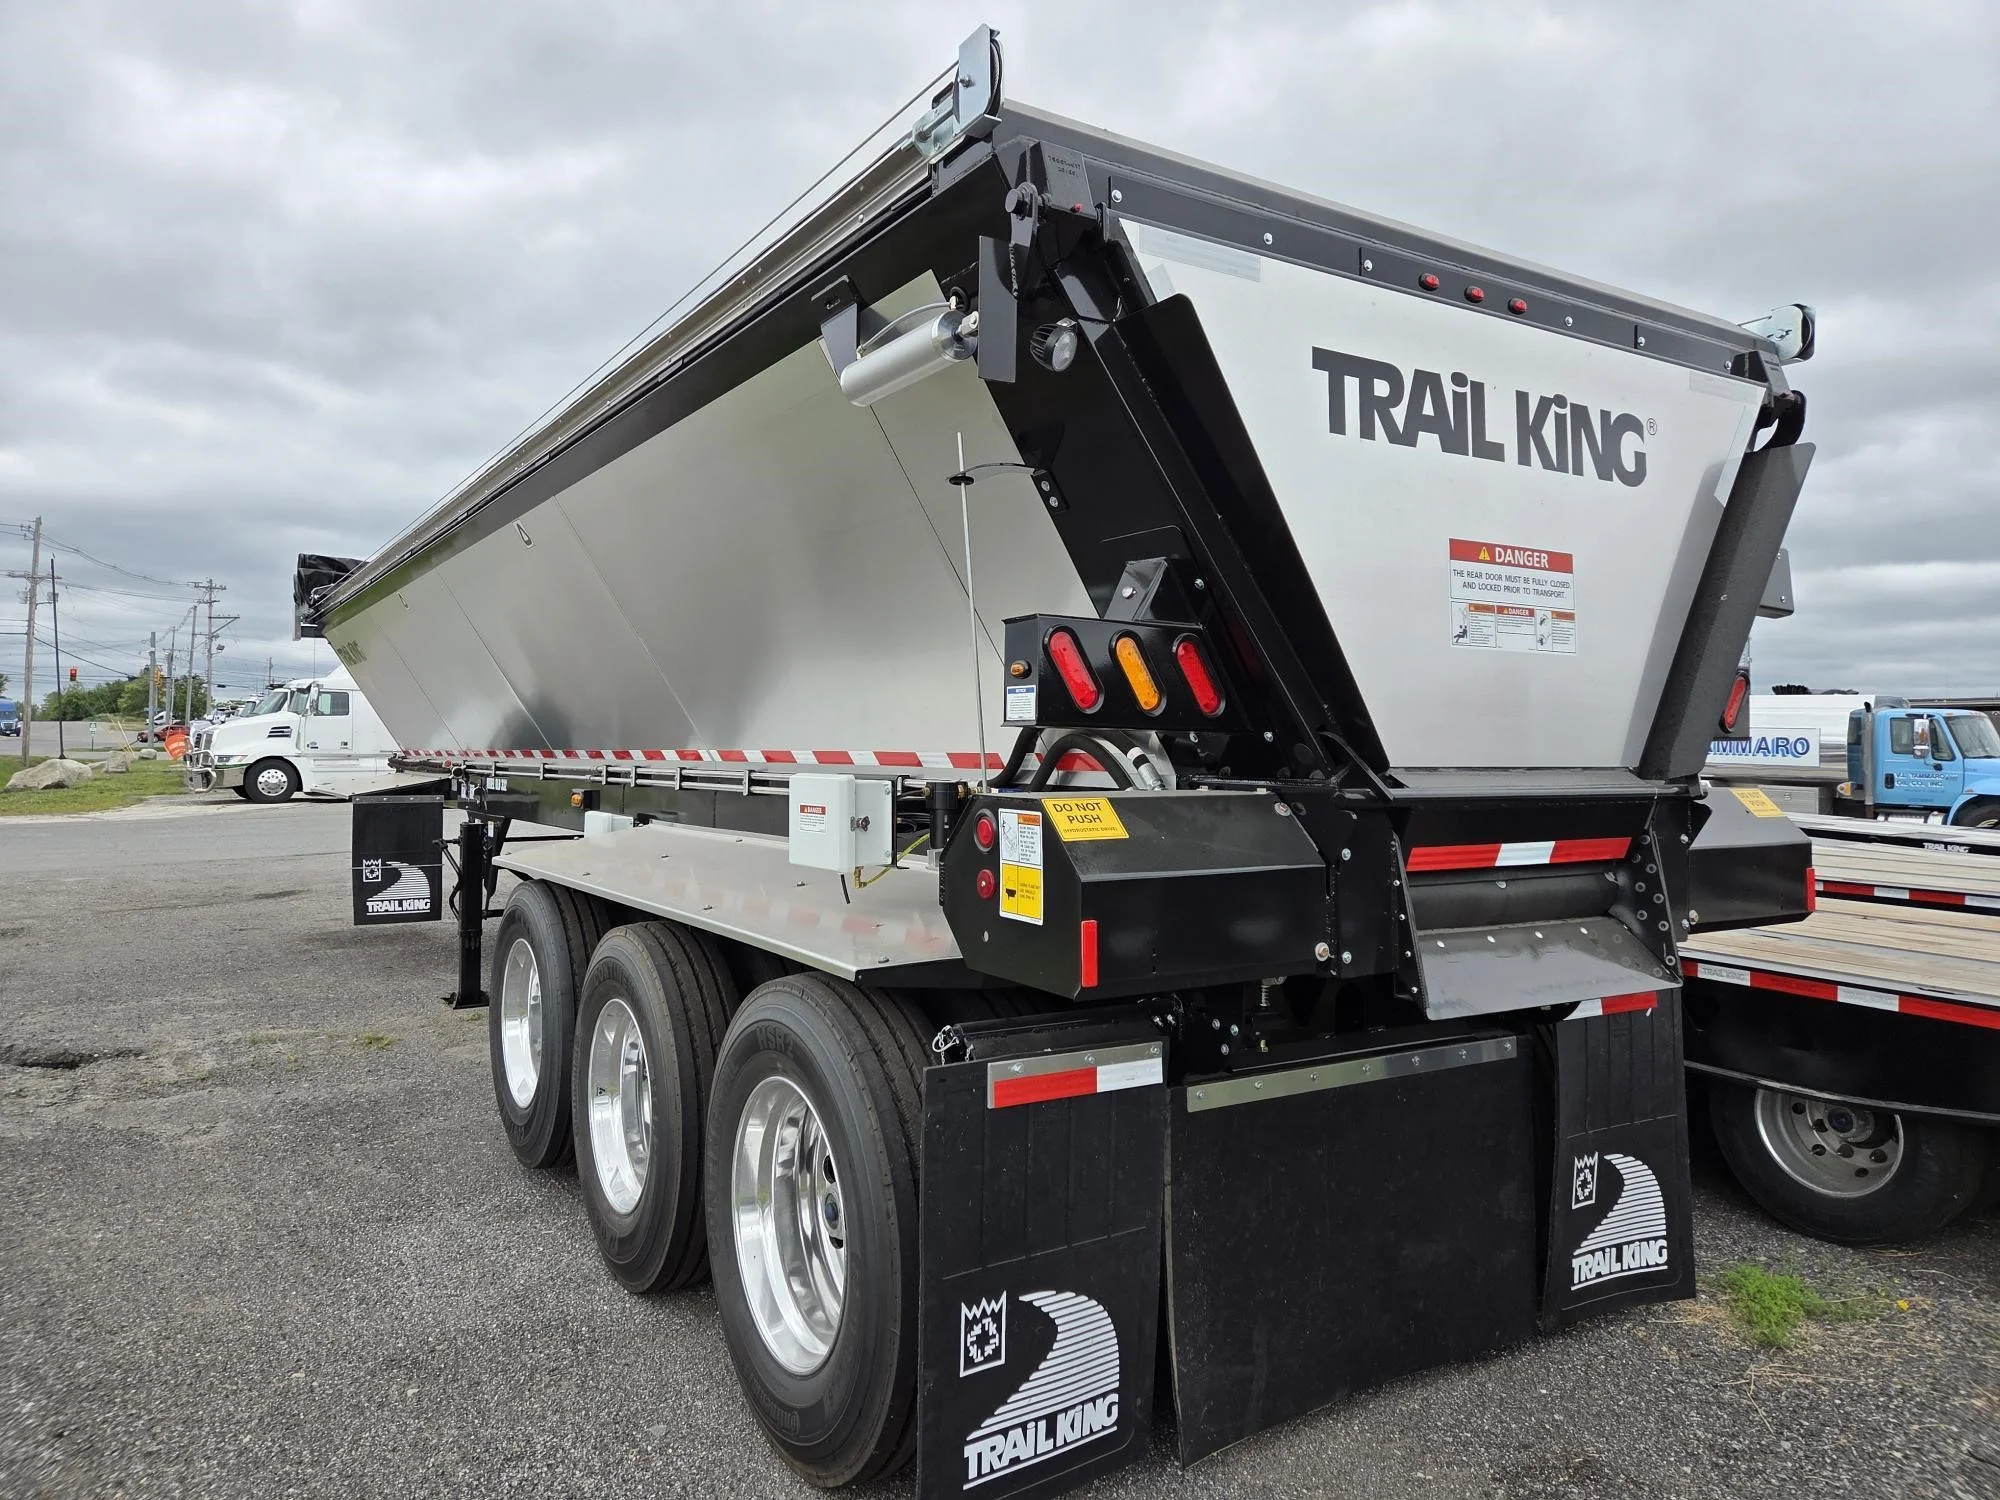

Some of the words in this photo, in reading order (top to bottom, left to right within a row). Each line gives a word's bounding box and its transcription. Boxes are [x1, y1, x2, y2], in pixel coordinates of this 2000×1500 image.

[1495, 547, 1549, 569] DANGER
[1453, 569, 1464, 578] THE
[1466, 570, 1483, 580] REAR
[1485, 572, 1503, 582] DOOR
[1505, 574, 1521, 584] MUST
[1523, 576, 1531, 585] BE
[1532, 578, 1548, 587] FULLY
[1463, 581, 1476, 590] AND
[1478, 582, 1501, 592] LOCKED
[1503, 585, 1521, 594] PRIOR
[1523, 587, 1531, 595] TO
[1508, 608, 1529, 616] DANGER
[1709, 736, 1810, 757] MMARO
[1053, 803, 1073, 813] DO
[1075, 802, 1102, 812] NOT
[1067, 814, 1103, 825] PUSH
[756, 1026, 796, 1059] HSR2
